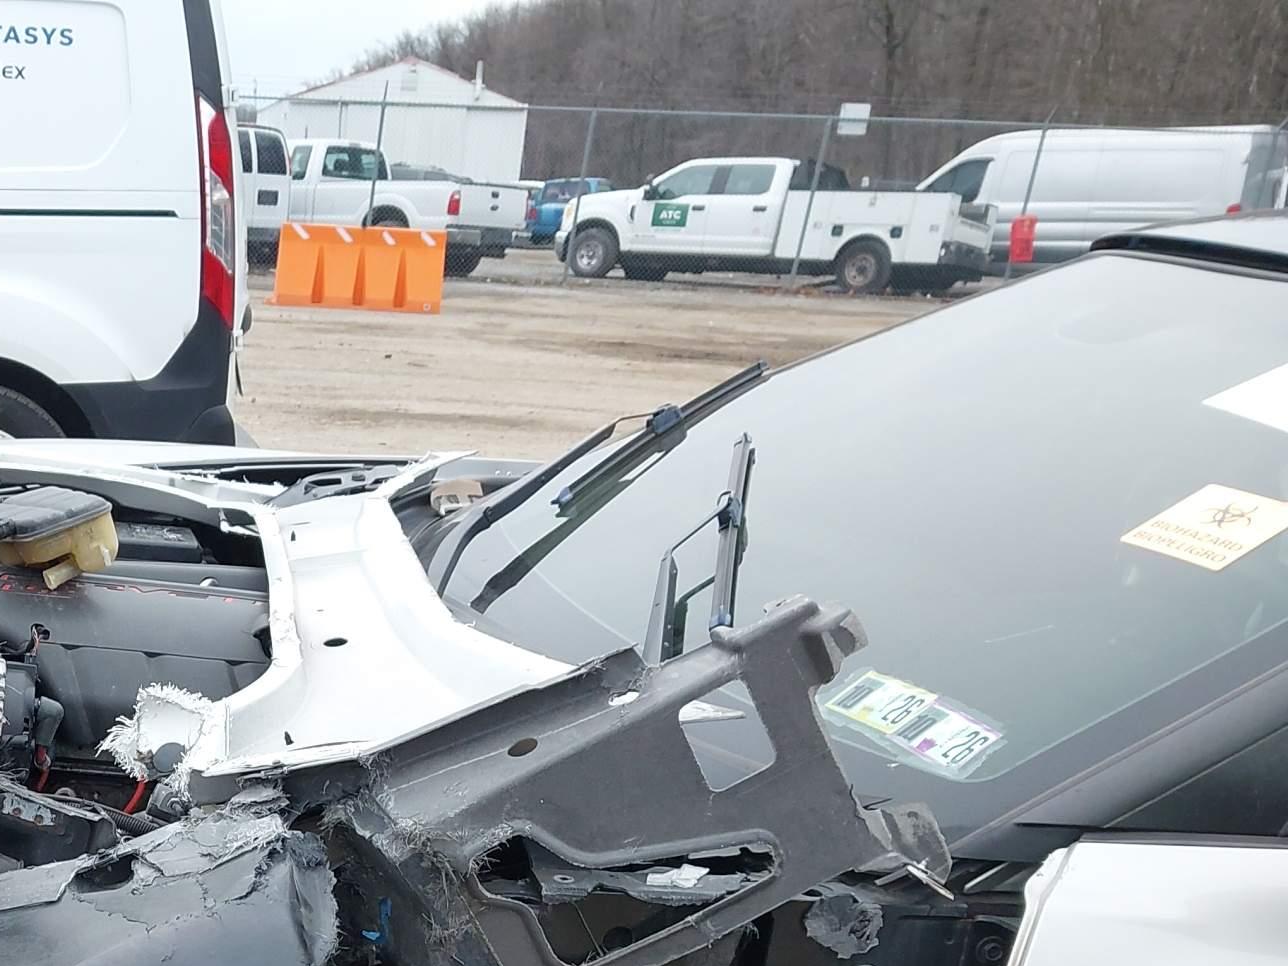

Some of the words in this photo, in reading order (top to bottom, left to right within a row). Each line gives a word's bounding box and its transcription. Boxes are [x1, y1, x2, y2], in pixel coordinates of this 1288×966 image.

[659, 209, 682, 220] ATC
[1133, 530, 1228, 563] BIOPELIGRO
[1151, 519, 1243, 552] BIOHAZARD
[881, 694, 926, 726] 26
[940, 730, 991, 765] 26
